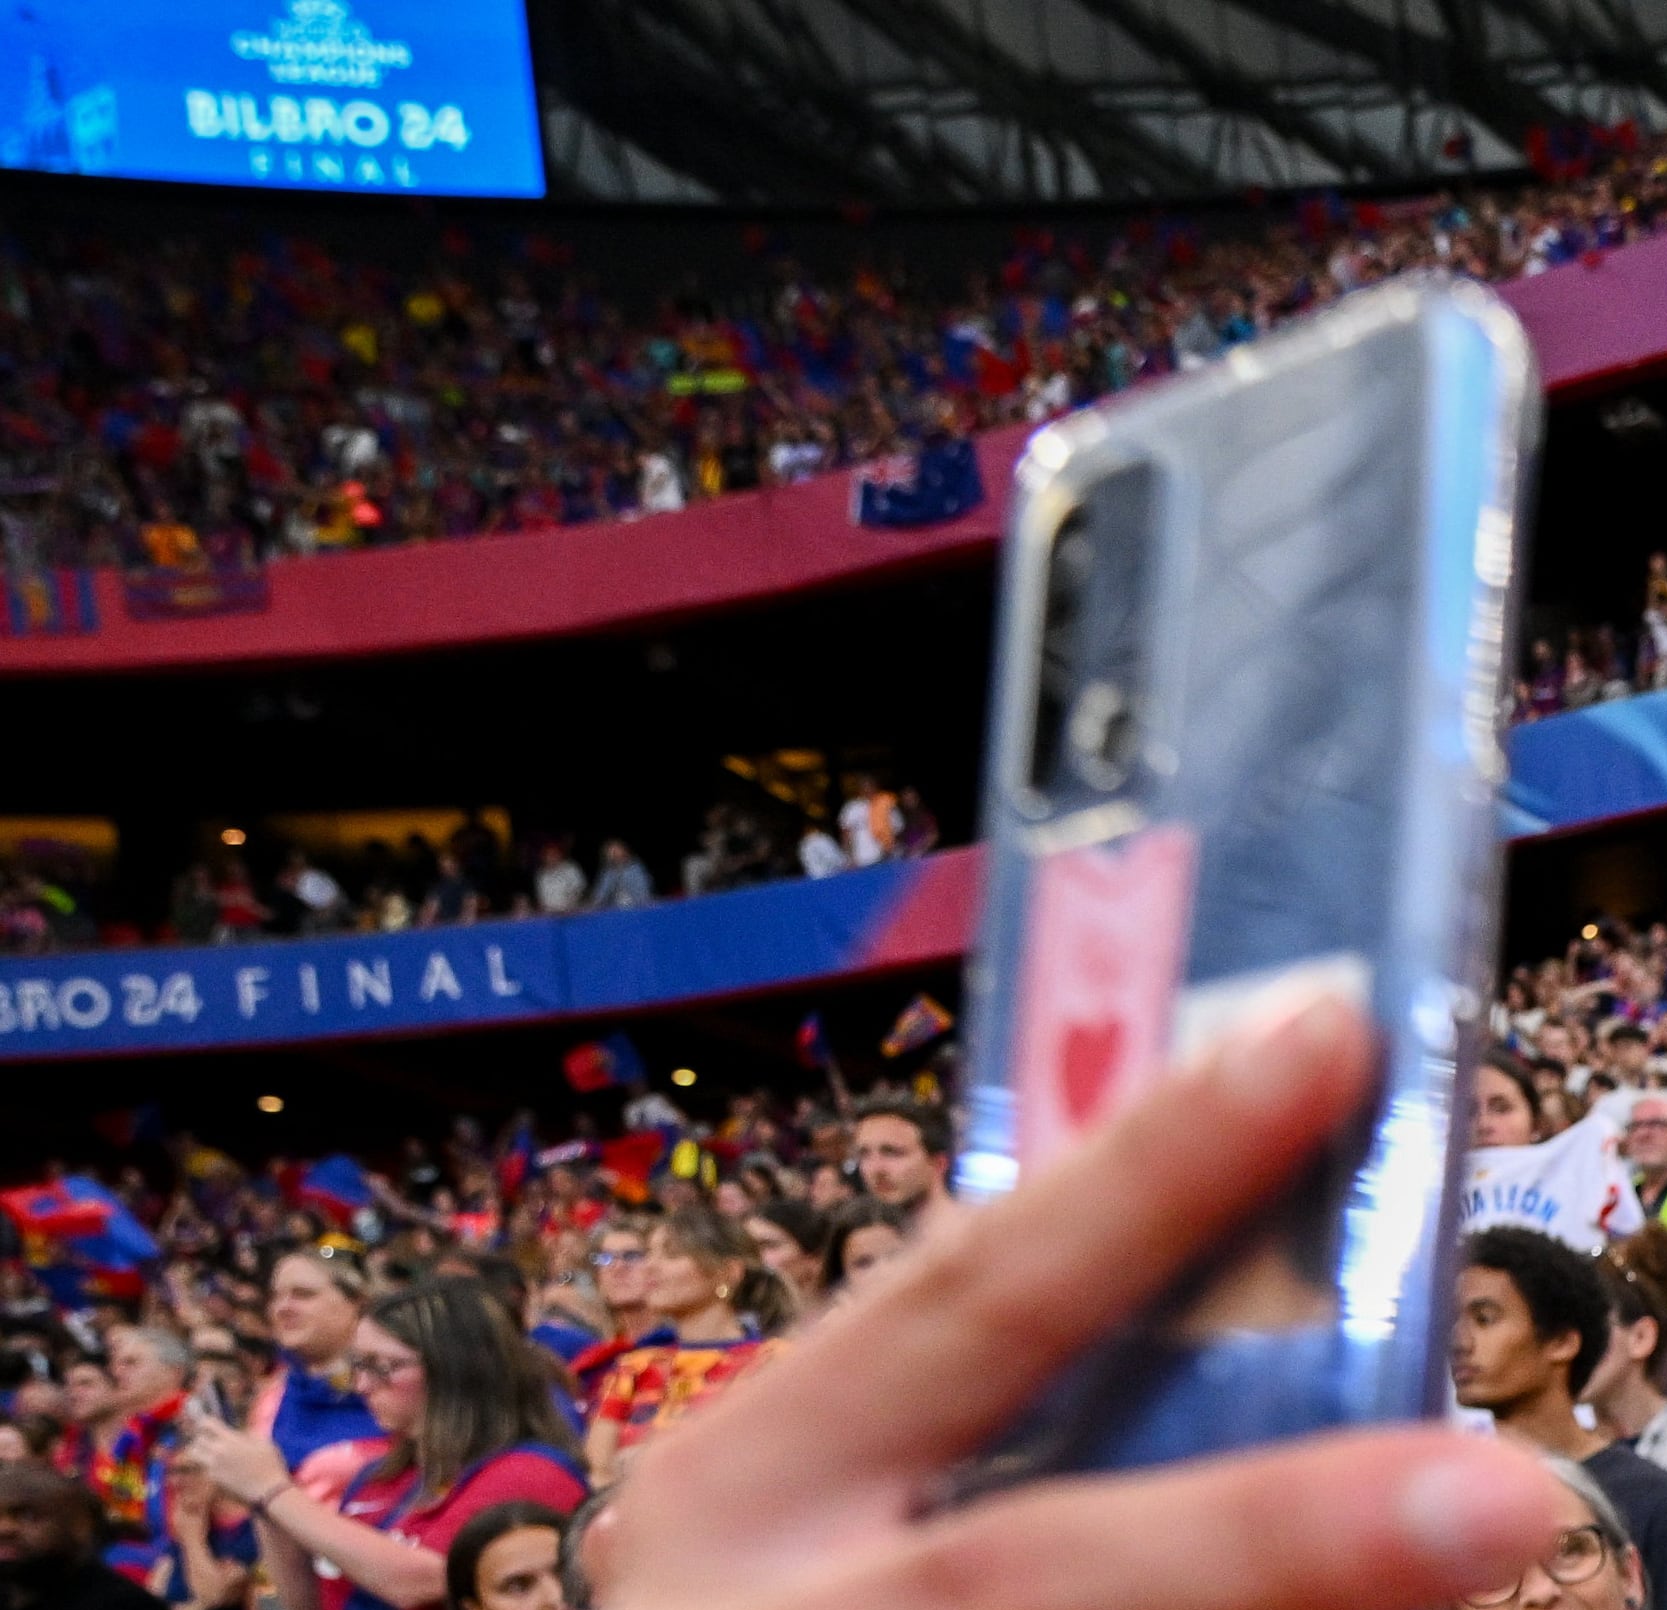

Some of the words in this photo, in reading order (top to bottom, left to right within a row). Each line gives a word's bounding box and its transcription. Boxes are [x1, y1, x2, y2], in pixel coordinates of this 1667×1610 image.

[396, 102, 472, 152] 24
[250, 149, 418, 187] FINAL
[119, 972, 203, 1027] 24
[234, 944, 522, 1020] FINAL
